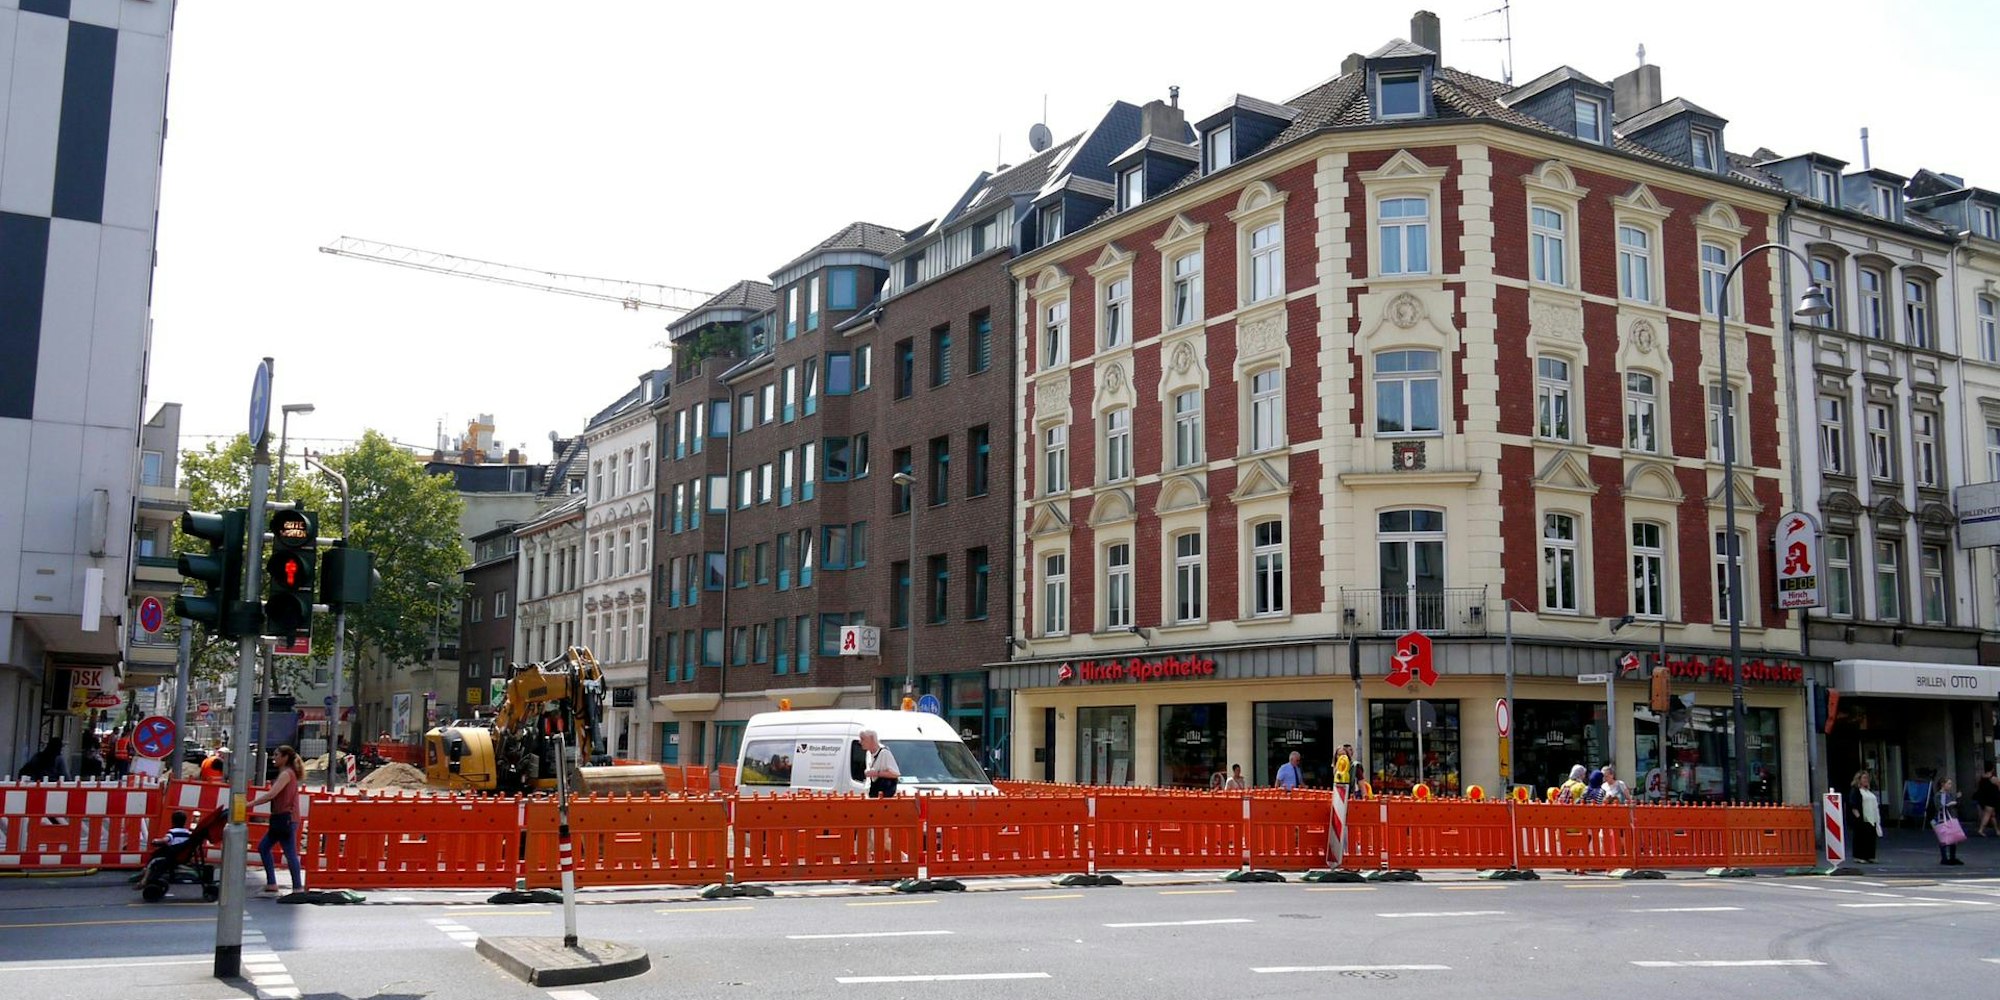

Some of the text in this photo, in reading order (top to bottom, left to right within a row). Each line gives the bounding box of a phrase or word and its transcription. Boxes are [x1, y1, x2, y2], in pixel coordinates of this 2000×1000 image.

[1788, 591, 1808, 599] Hirsch
[1782, 598, 1815, 607] Apotheke
[1080, 653, 1215, 683] Hirsch-Apotheke
[1916, 675, 1978, 689] BRILLEN OTTO
